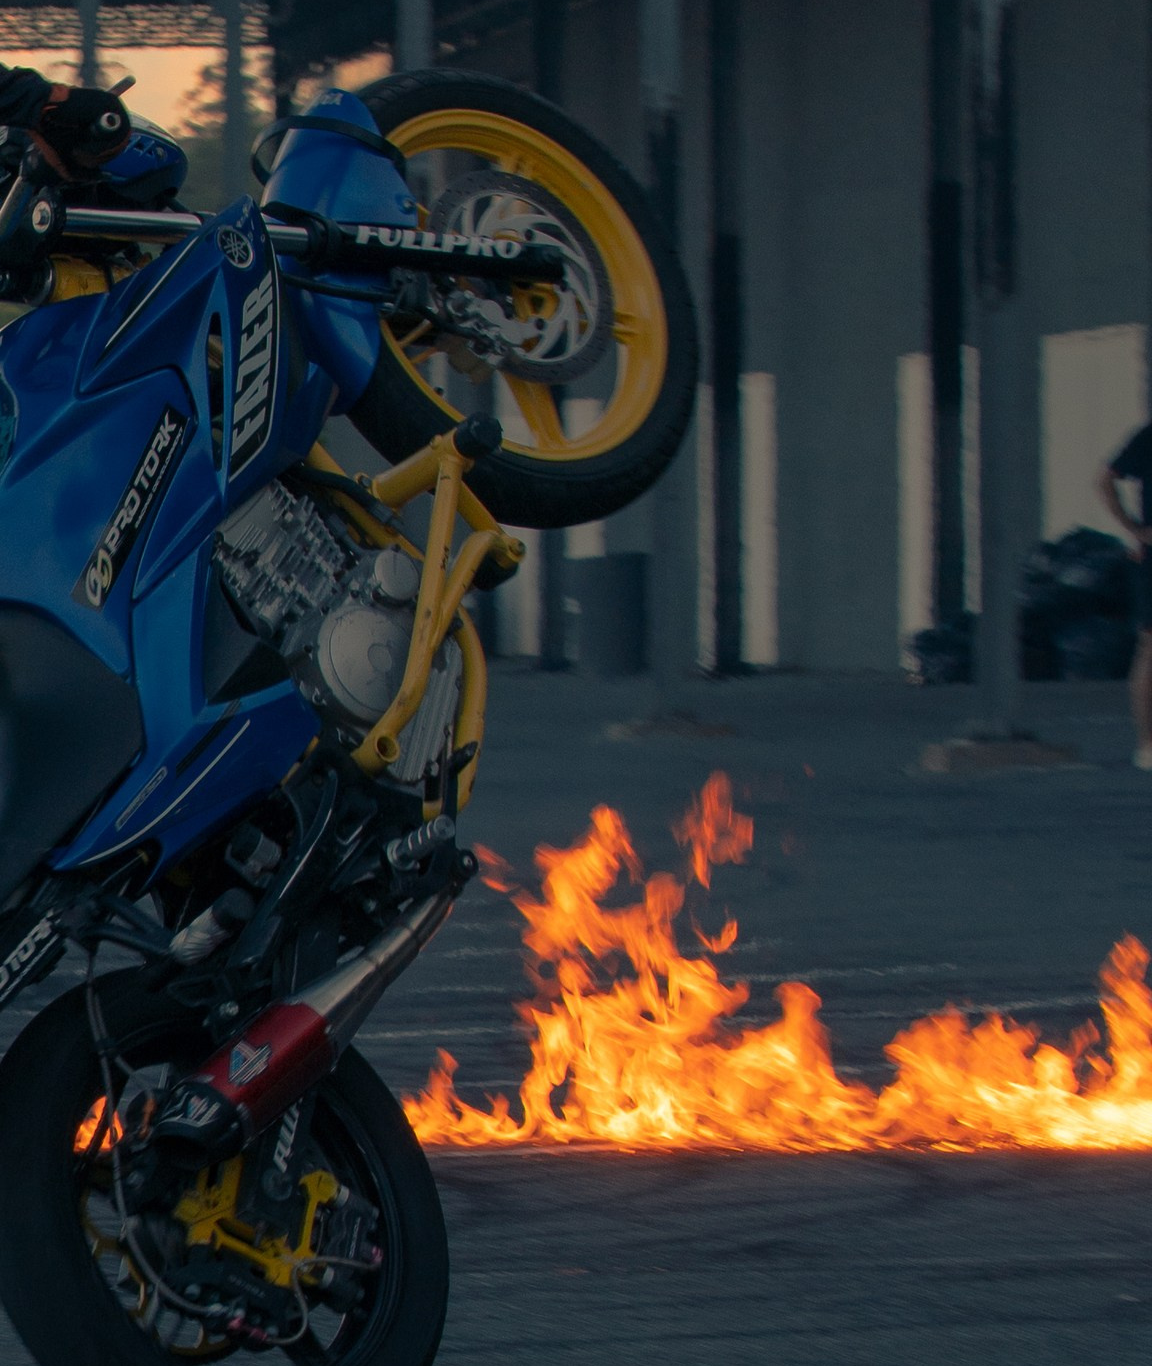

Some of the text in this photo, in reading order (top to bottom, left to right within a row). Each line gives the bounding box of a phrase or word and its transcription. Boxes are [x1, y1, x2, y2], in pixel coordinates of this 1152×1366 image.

[355, 225, 522, 259] FULLPRO
[230, 270, 273, 456] FAZER
[104, 410, 177, 552] PRO TORK
